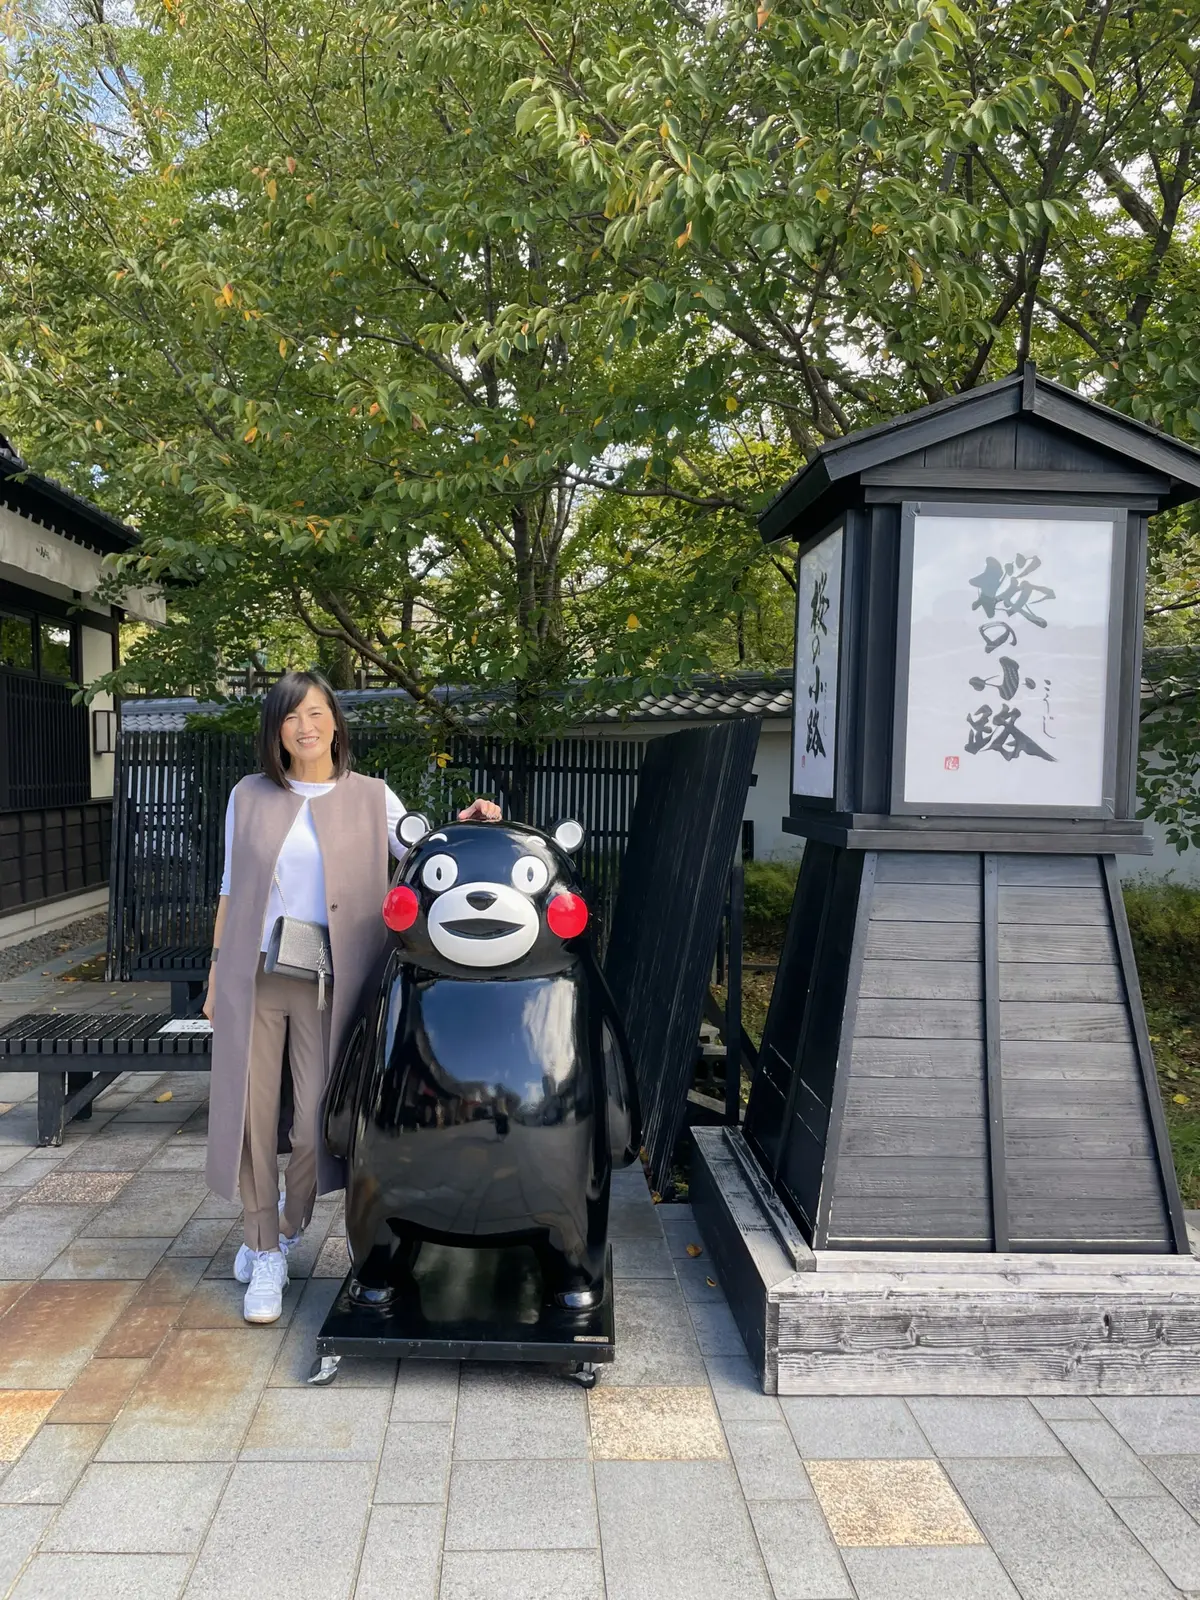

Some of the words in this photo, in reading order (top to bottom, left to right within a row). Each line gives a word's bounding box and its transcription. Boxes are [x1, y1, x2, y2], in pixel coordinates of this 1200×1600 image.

[805, 571, 830, 759] 桜の小路
[964, 552, 1058, 762] 桜の小路
